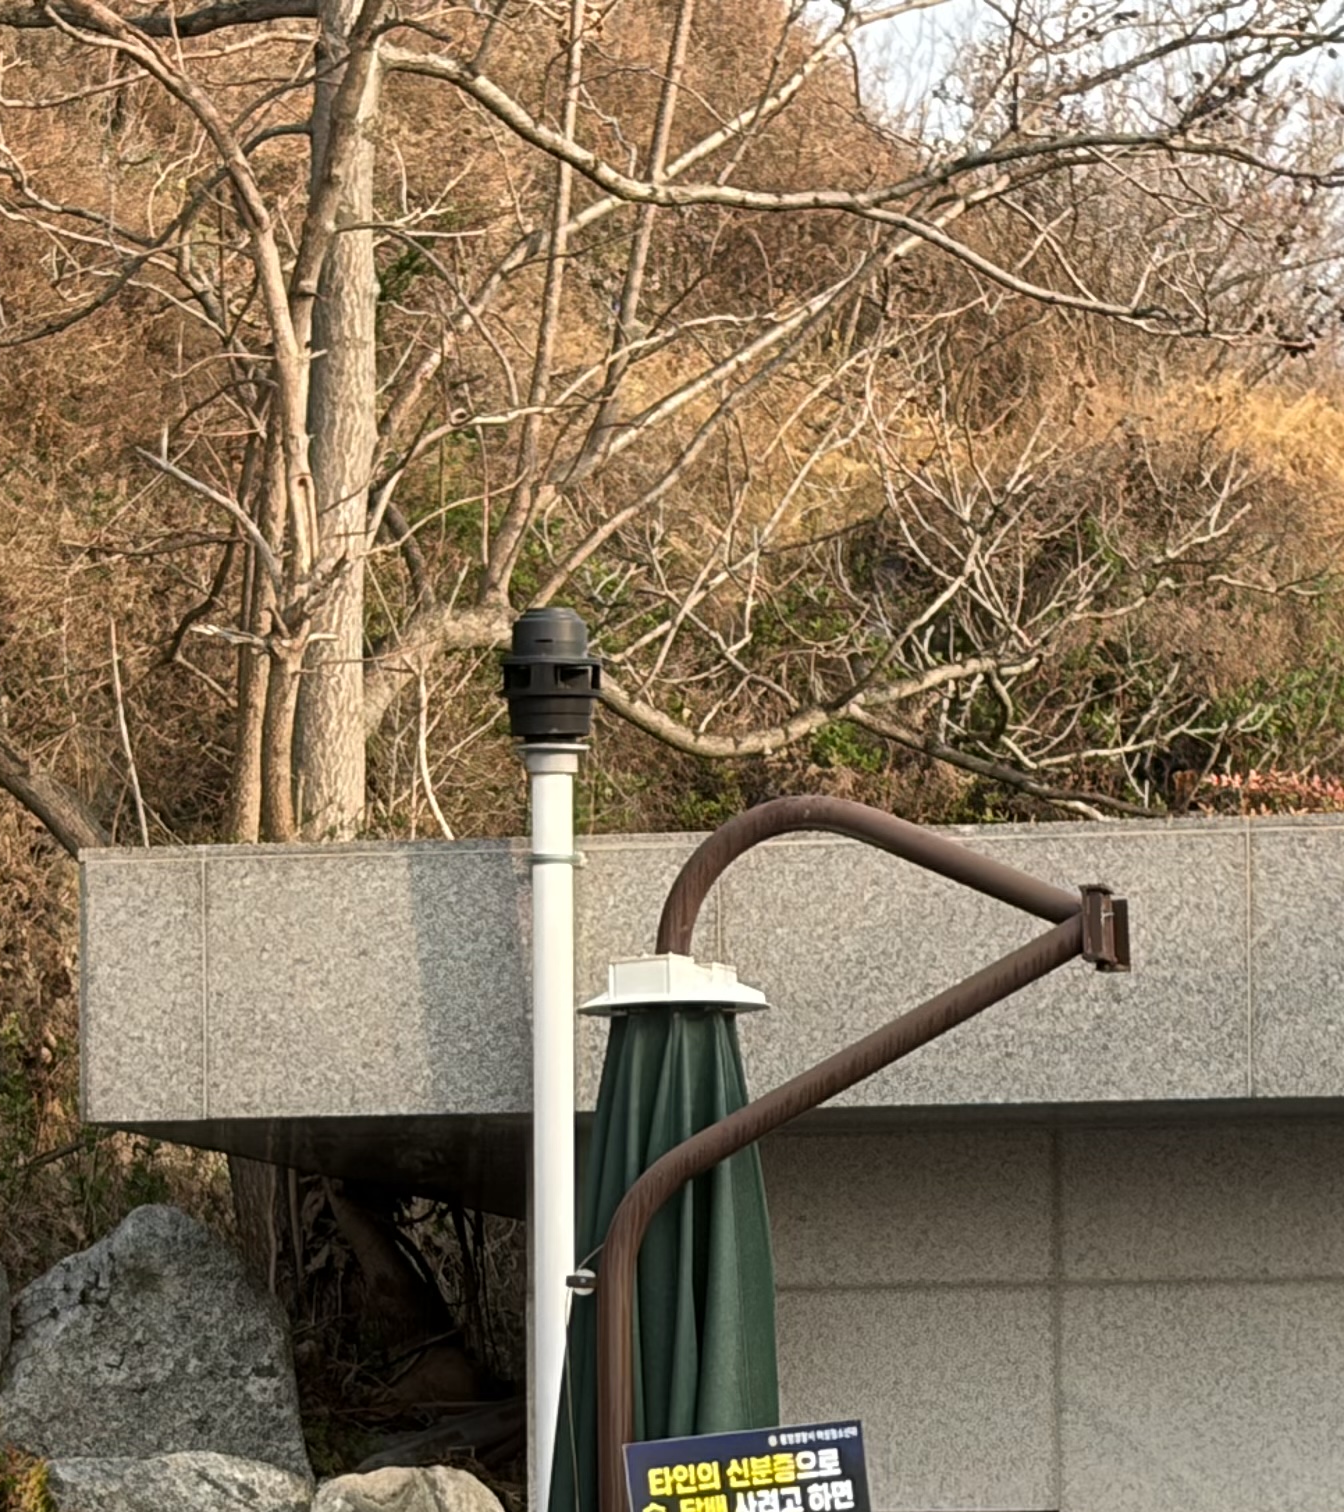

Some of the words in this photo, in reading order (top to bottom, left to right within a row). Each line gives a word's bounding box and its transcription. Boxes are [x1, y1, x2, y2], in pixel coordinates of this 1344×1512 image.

[647, 1460, 722, 1497] 타인의
[726, 1447, 842, 1489] 신분증으로
[807, 1479, 855, 1512] 하면
